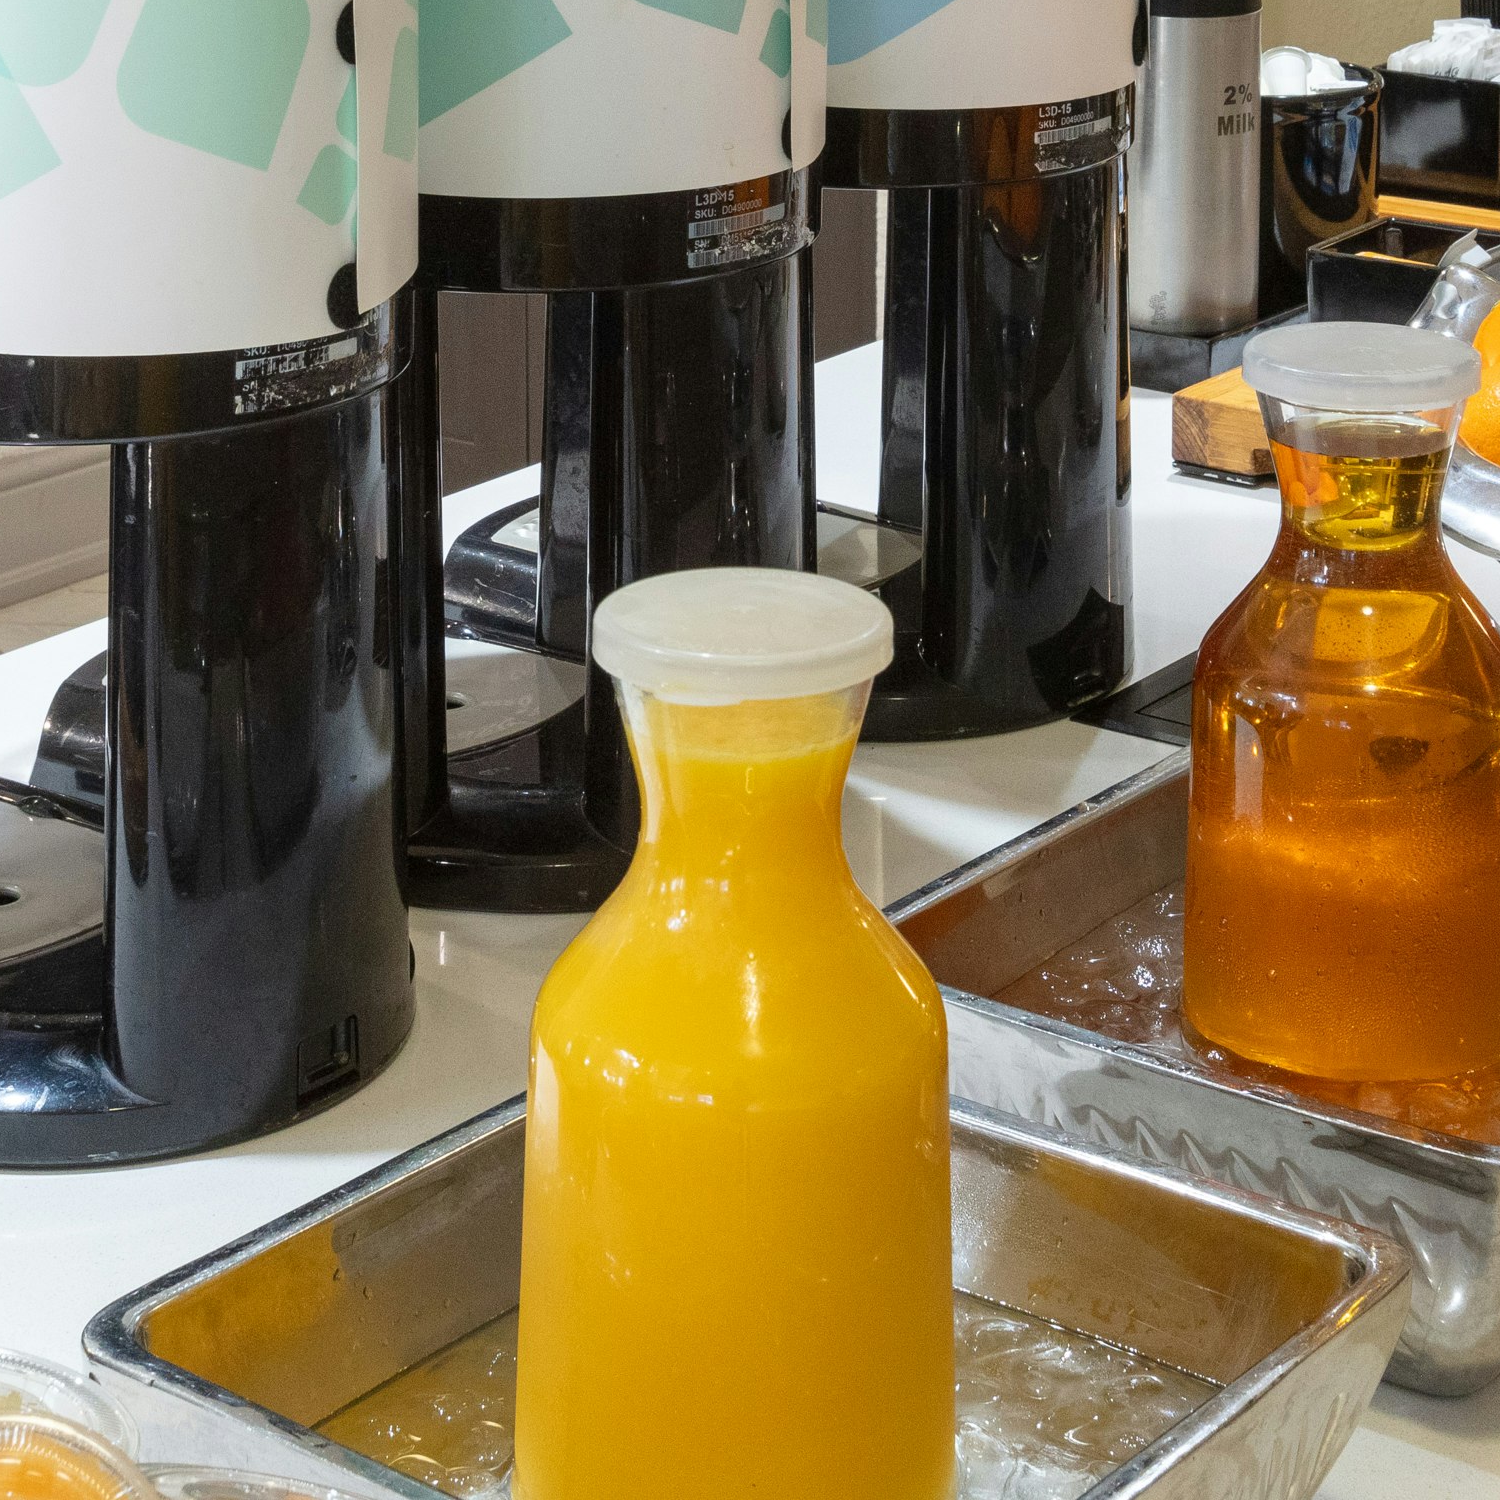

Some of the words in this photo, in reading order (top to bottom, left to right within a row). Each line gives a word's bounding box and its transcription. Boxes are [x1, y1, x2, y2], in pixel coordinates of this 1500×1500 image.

[1223, 82, 1254, 106] 2%
[1038, 102, 1072, 118] L3D-15
[1038, 119, 1057, 130] SKU:
[1217, 112, 1256, 137] Milk
[695, 189, 736, 207] L3D-15
[694, 208, 717, 220] SKU:
